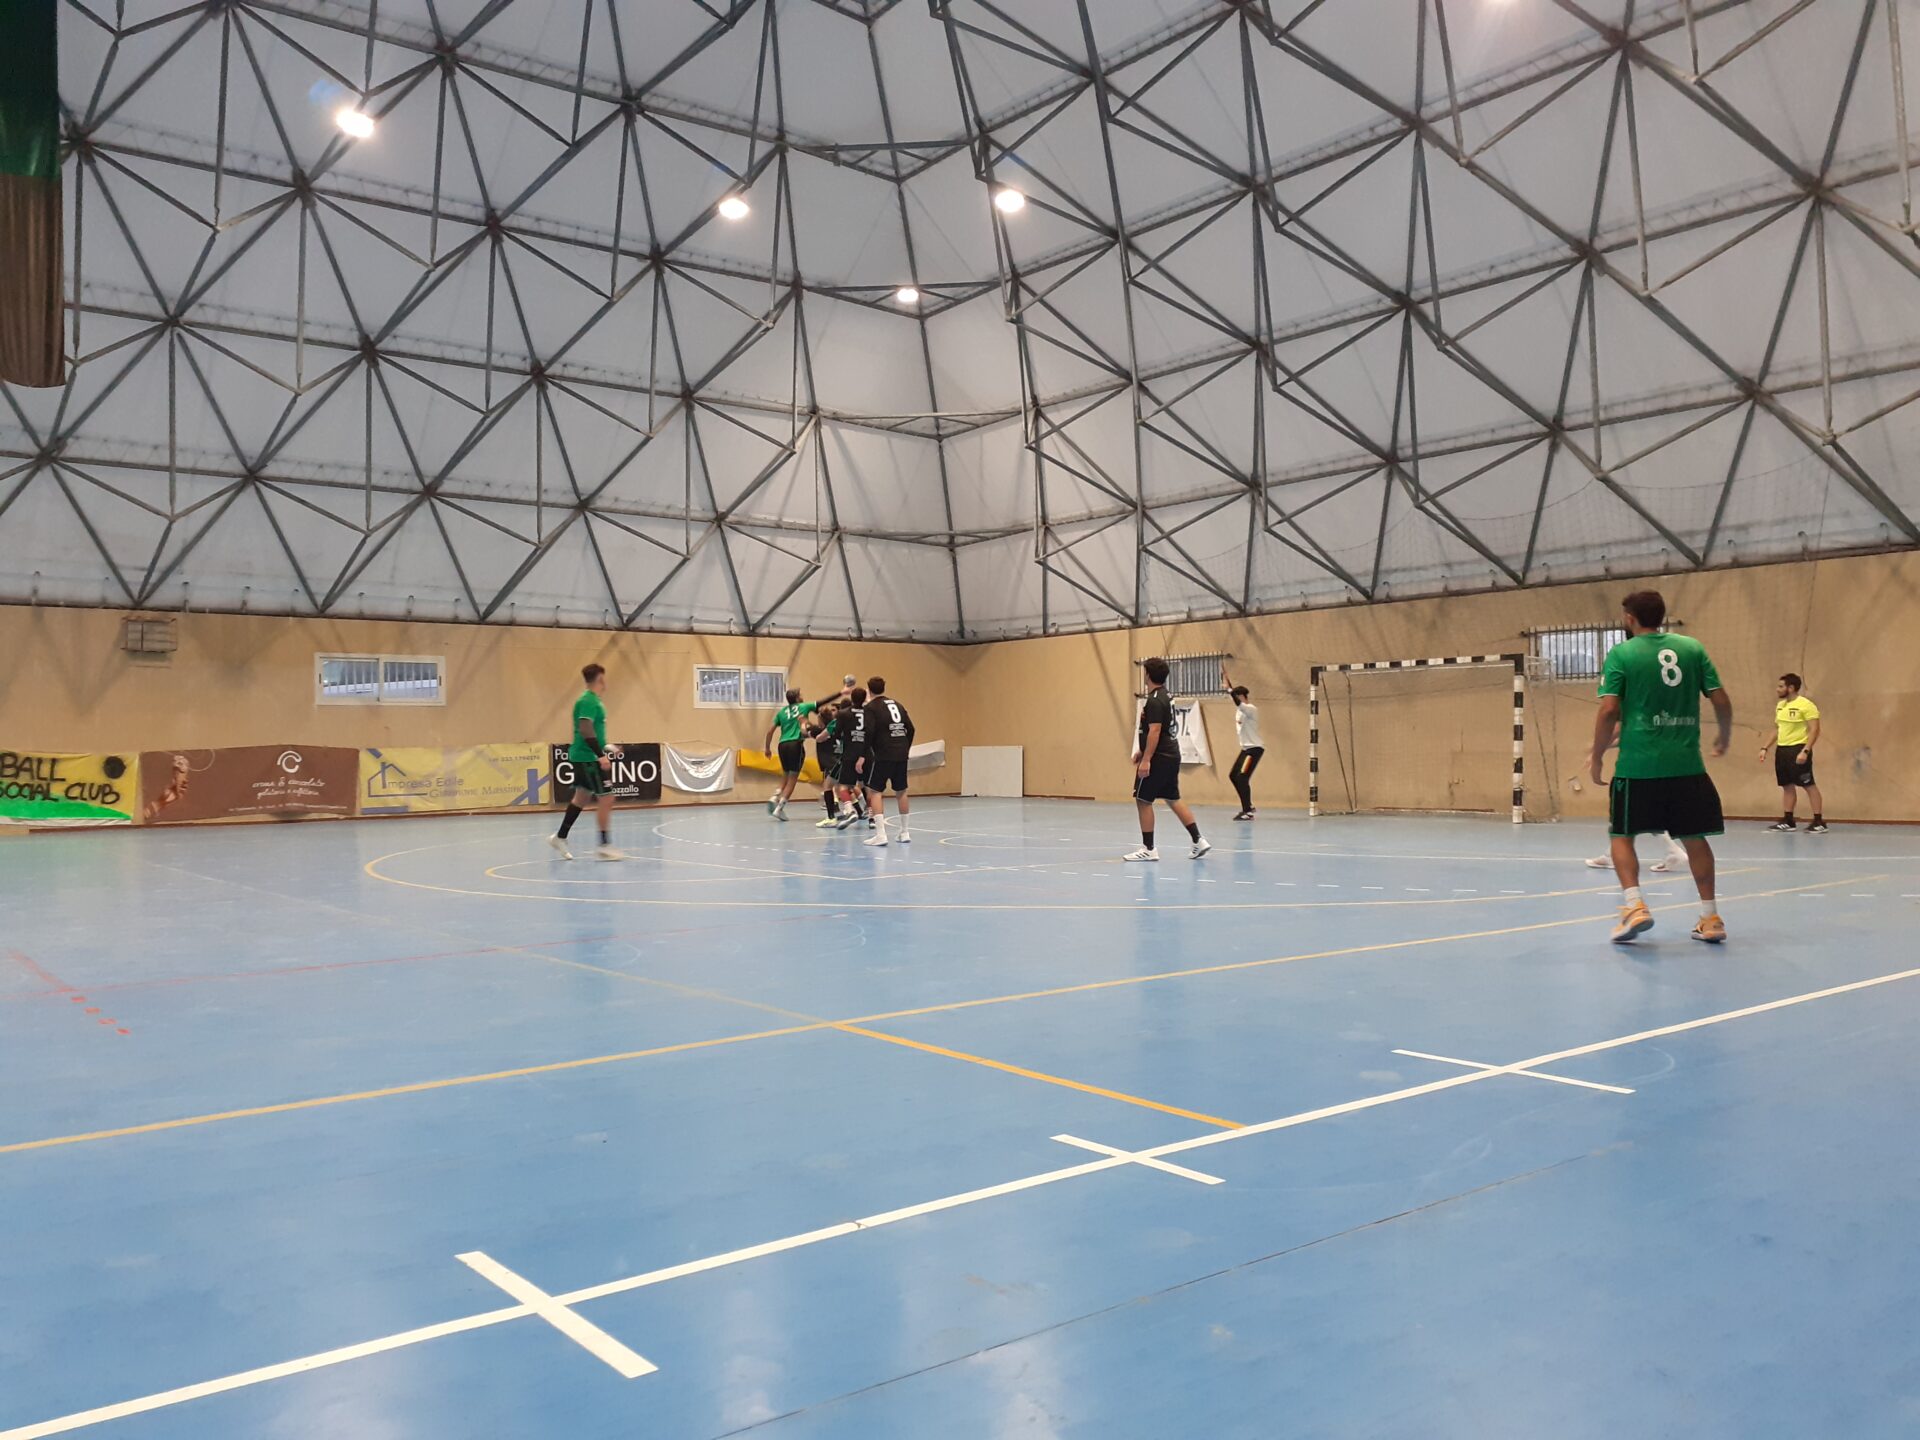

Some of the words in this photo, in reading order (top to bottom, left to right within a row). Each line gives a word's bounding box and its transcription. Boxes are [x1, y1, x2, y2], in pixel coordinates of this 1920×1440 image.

[1658, 649, 1682, 687] 8
[785, 706, 799, 719] 13
[888, 704, 901, 722] 8
[0, 752, 66, 781] BALL
[64, 782, 120, 804] CLUB
[610, 785, 639, 794] ozzallo
